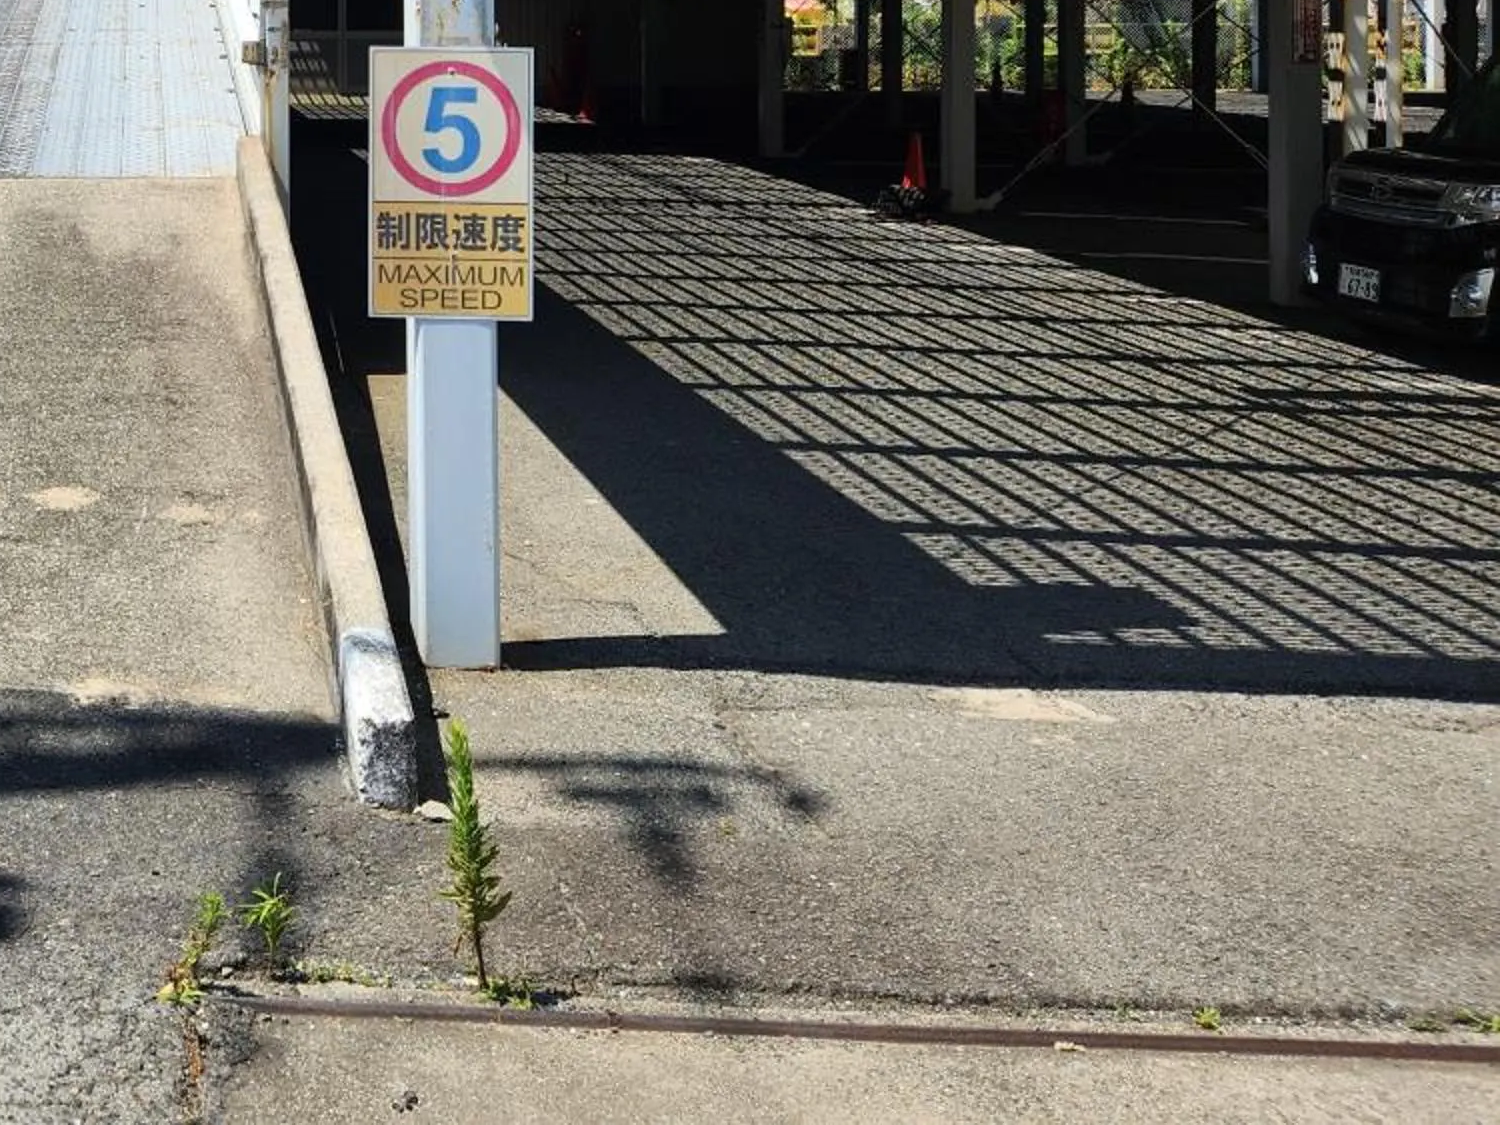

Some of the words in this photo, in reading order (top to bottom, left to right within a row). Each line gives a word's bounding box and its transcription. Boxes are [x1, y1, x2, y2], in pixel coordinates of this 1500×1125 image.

[421, 86, 481, 174] 5
[376, 211, 526, 253] 制限速度
[378, 263, 524, 288] MAXIMUM
[399, 288, 503, 311] SPEED
